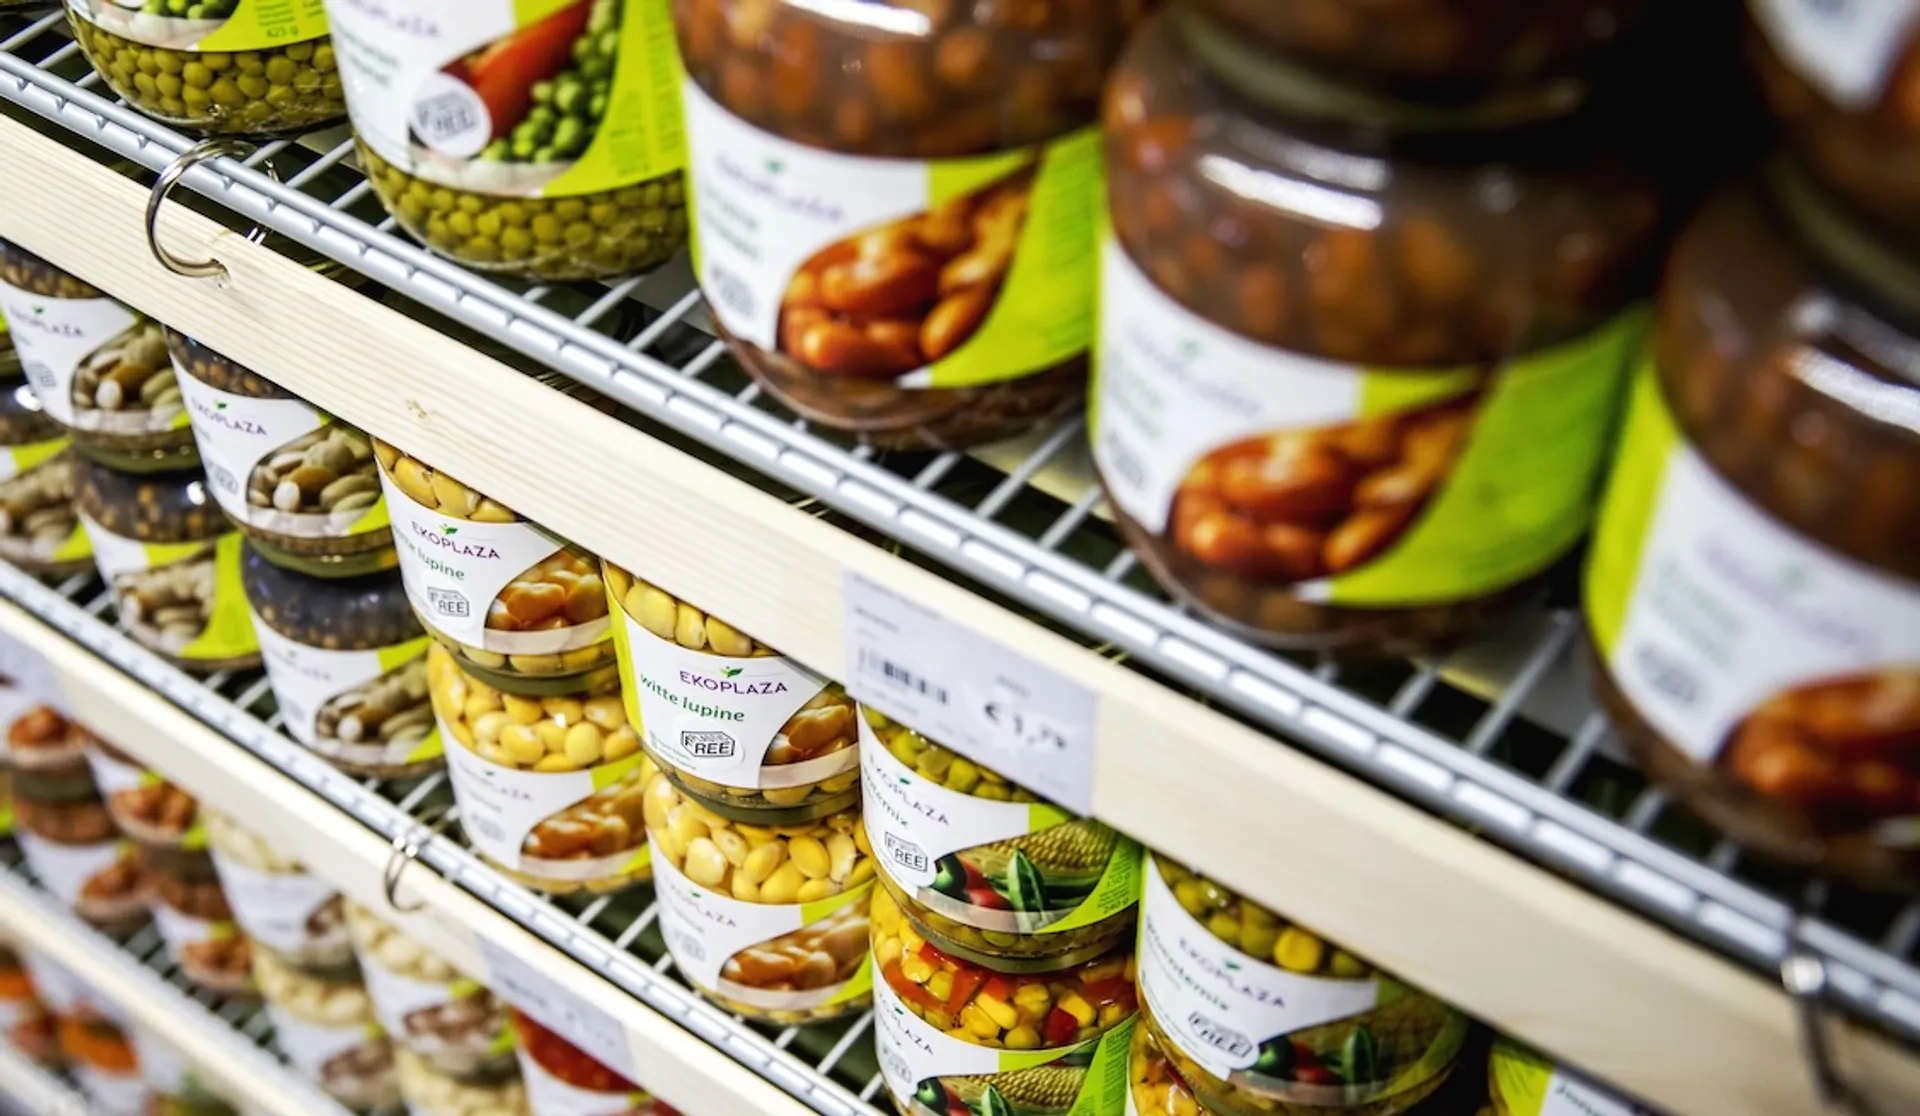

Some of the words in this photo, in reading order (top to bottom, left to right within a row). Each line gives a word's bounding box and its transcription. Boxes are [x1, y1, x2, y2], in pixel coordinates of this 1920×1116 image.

[411, 520, 501, 560] EKOPLAZA
[417, 546, 466, 581] lupine
[430, 592, 465, 613] FREE
[639, 674, 679, 705] witte
[682, 696, 746, 723] lupine
[679, 670, 788, 695] EKOPLAZA
[684, 735, 730, 755] FREE
[887, 836, 924, 868] FREE
